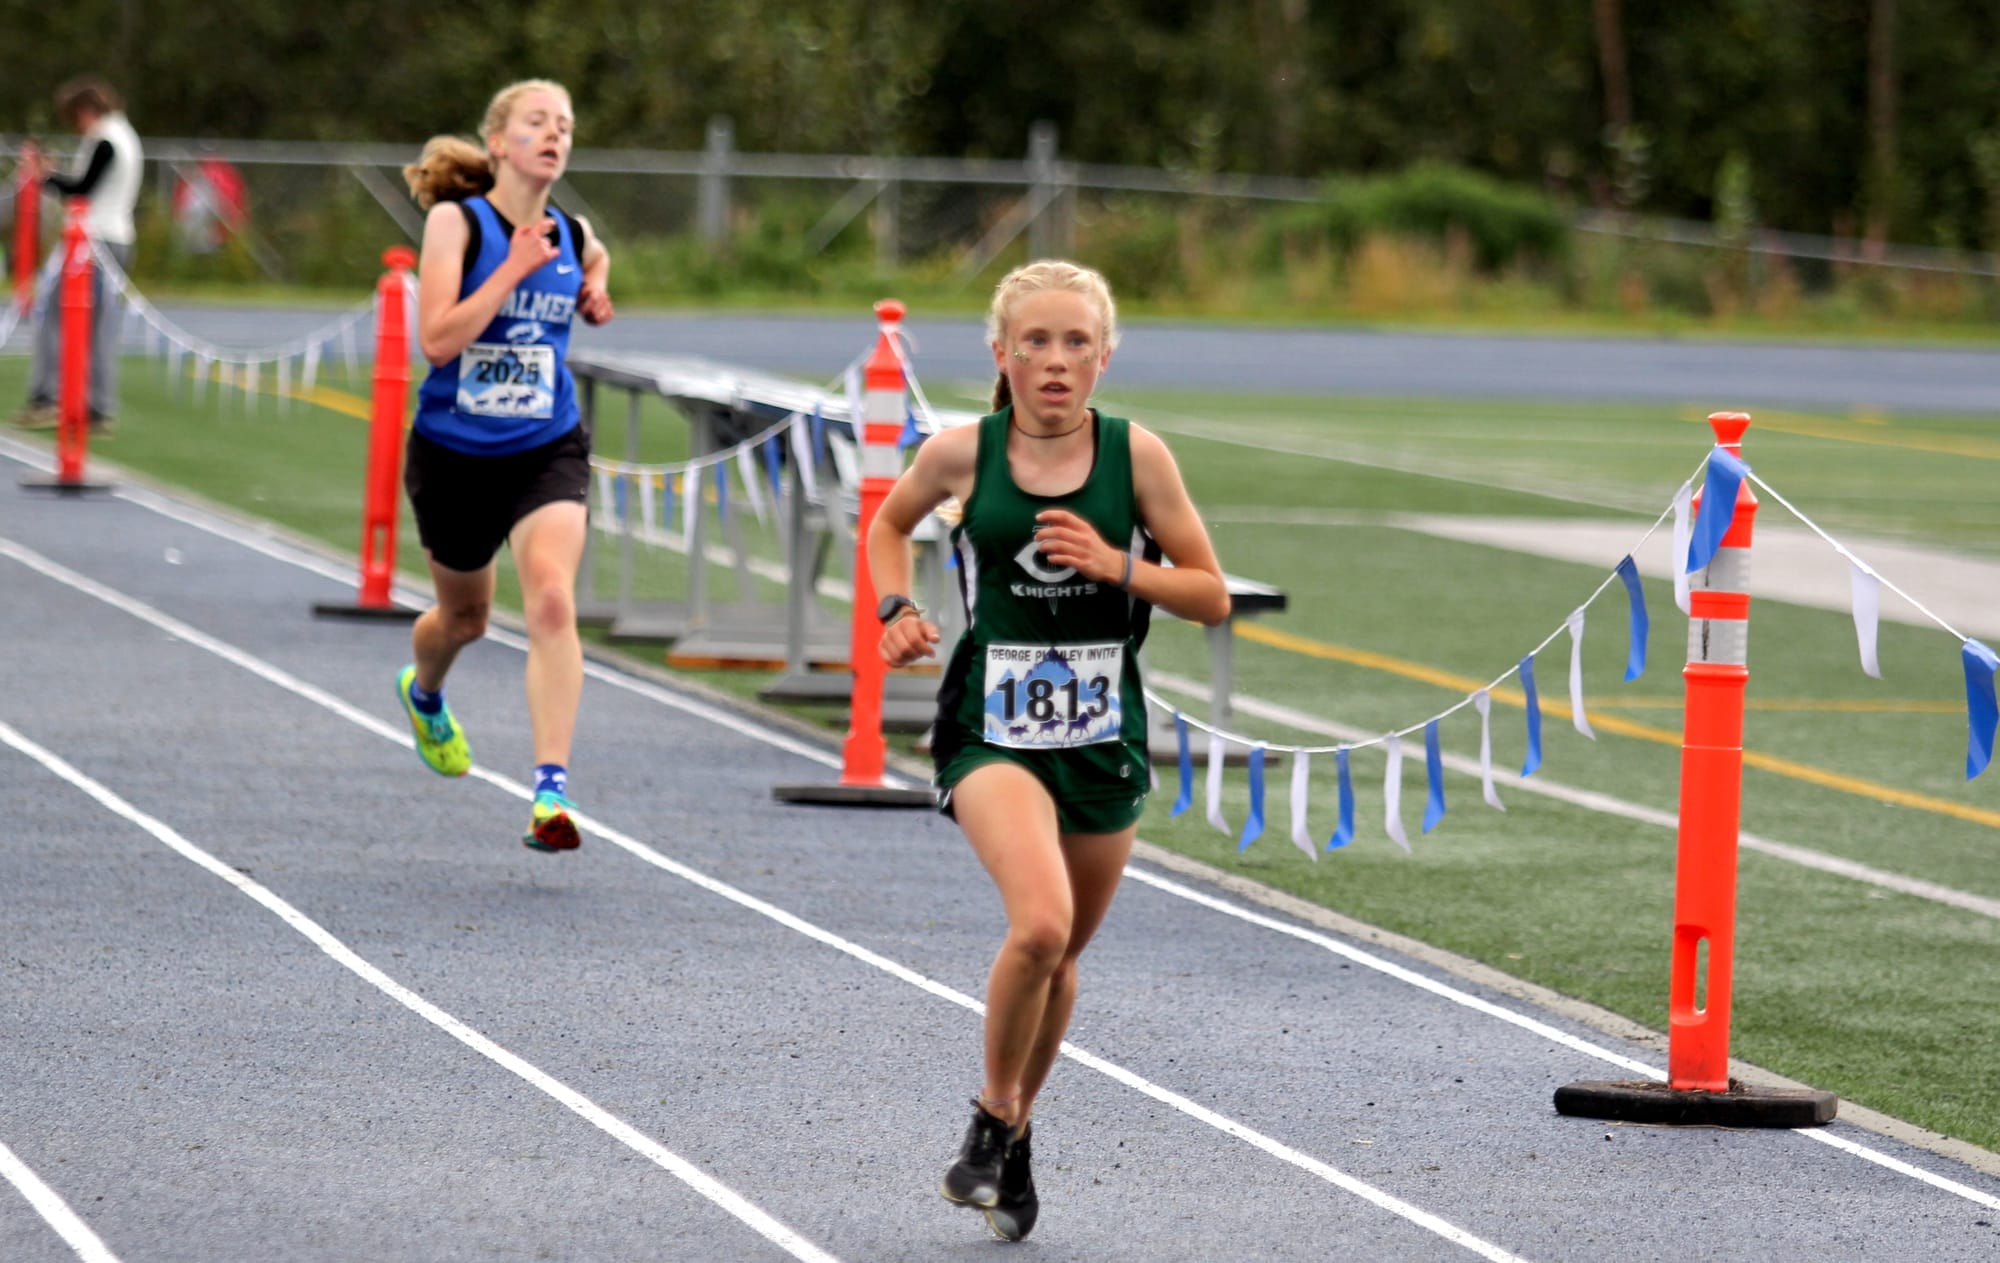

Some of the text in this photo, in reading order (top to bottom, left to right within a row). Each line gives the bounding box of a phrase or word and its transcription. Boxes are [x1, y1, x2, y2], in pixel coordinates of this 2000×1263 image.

[475, 360, 540, 385] 2025
[1010, 584, 1098, 598] KNIGHTS
[996, 675, 1110, 722] 1813
